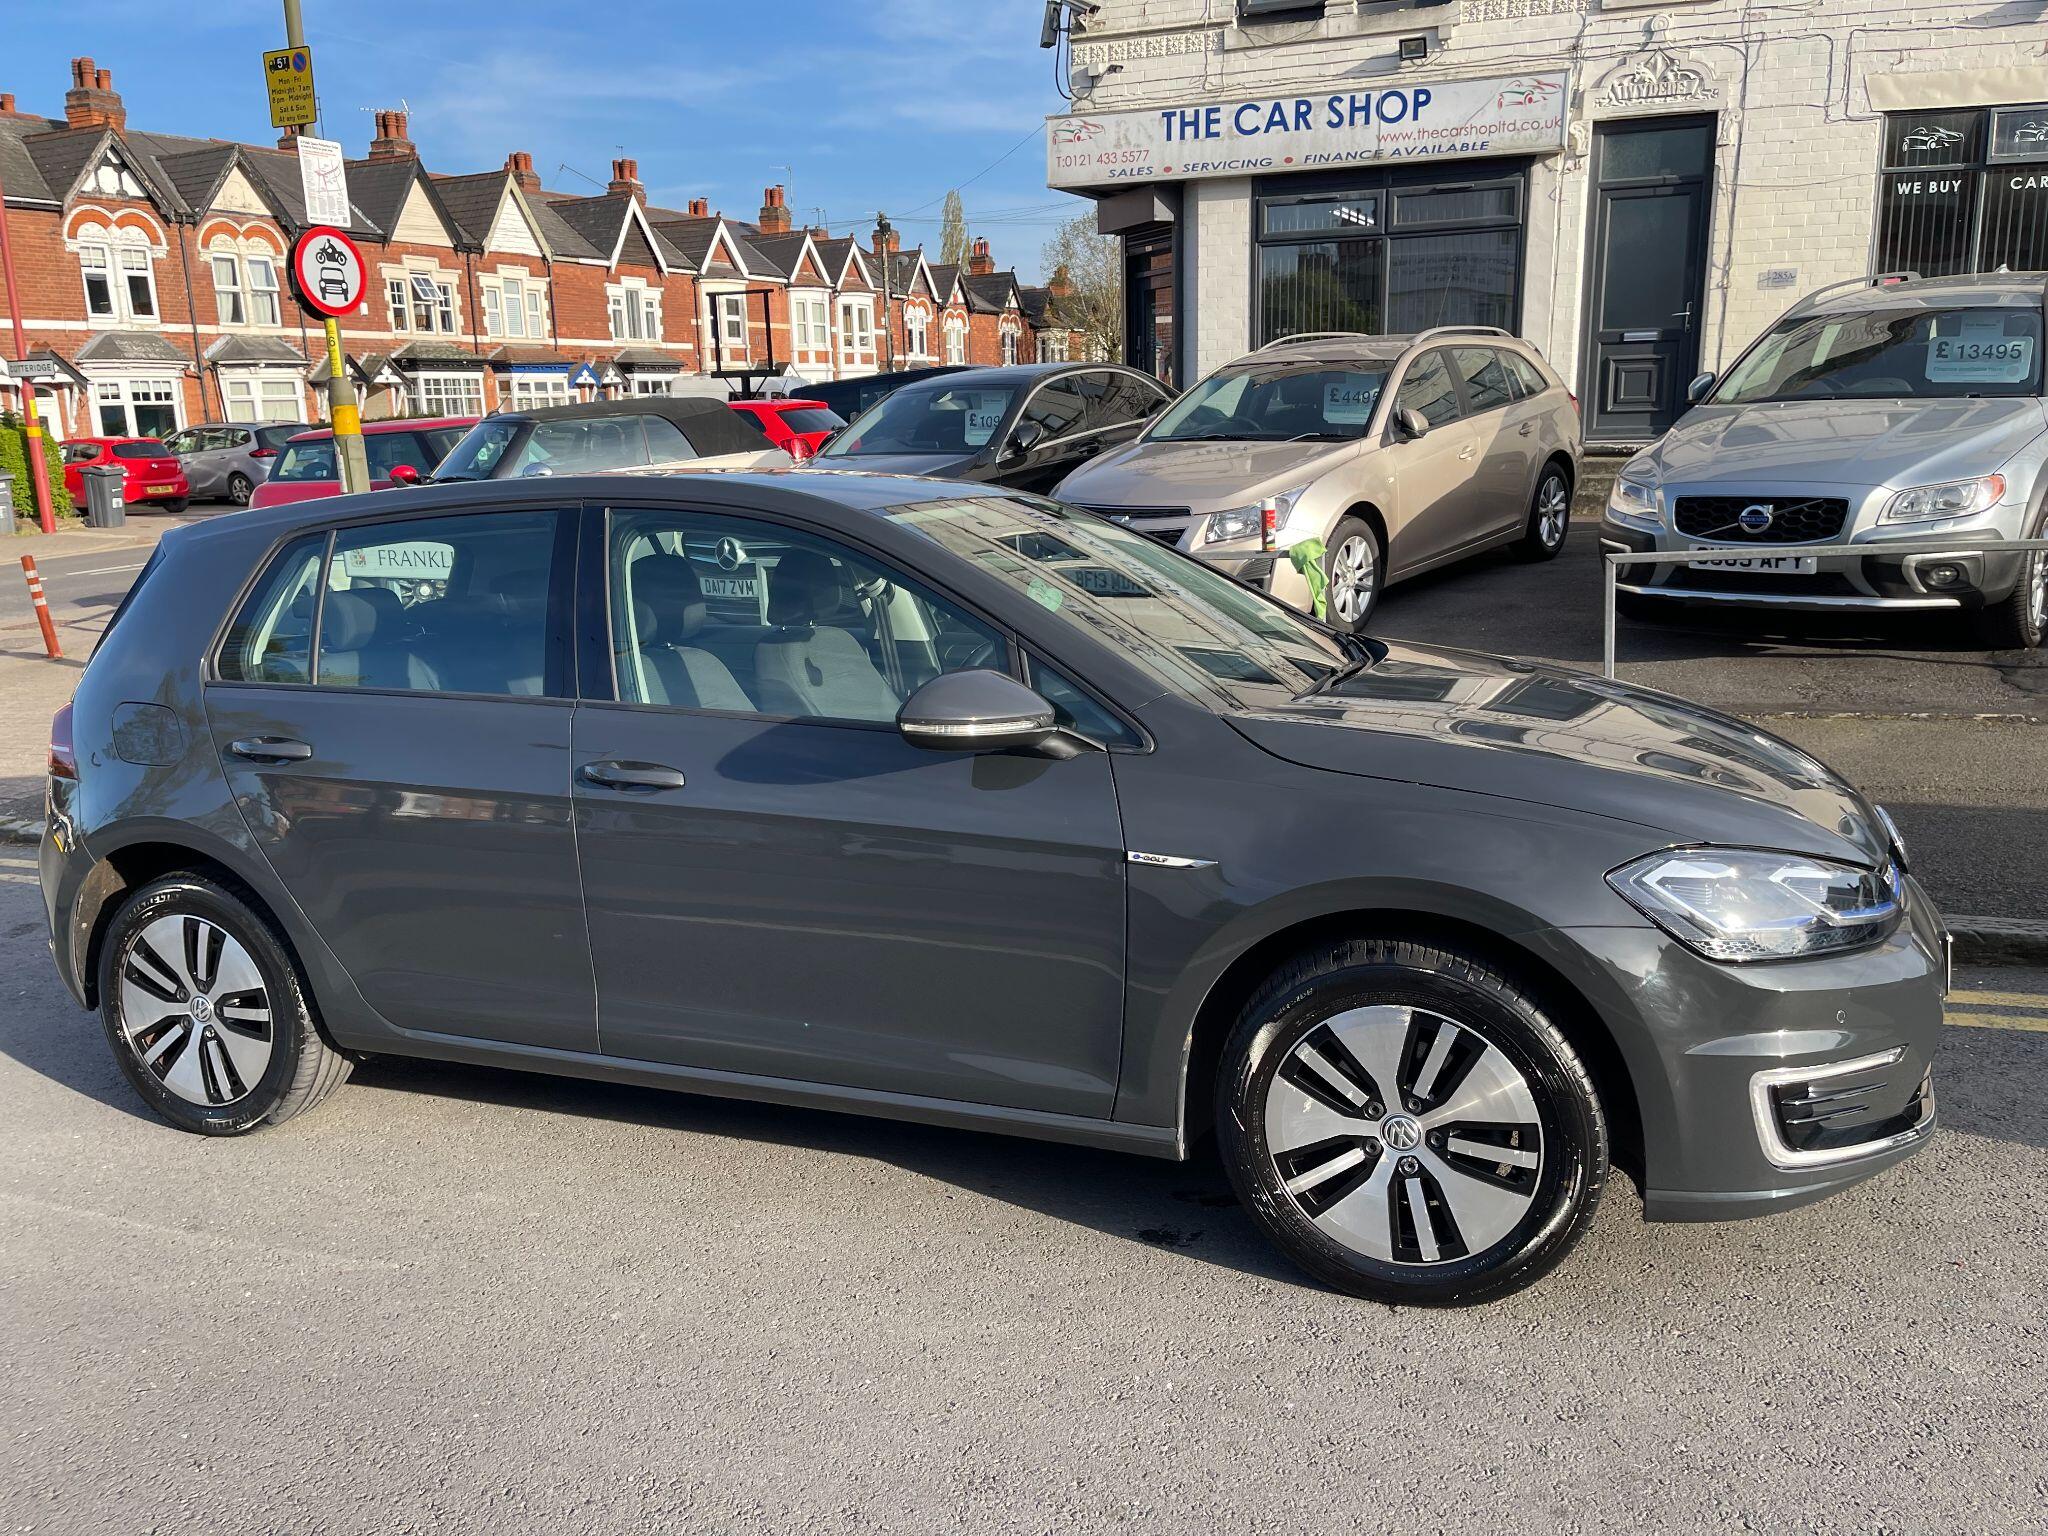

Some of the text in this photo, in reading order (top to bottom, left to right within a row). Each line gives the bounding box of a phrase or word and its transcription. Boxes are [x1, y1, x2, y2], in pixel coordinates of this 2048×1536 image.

[272, 87, 296, 95] Midnight
[289, 93, 312, 102] Midnight
[1161, 106, 1222, 142] THE
[1234, 99, 1313, 136] CAR
[1326, 88, 1432, 130] SHOP
[1376, 115, 1563, 143] www.thecarshopltd.co.uk
[1056, 150, 1150, 169] T:0121 433 5577
[1108, 141, 1490, 178] SALES SERVICING FINANCE AVAILABLE
[1897, 181, 1922, 195] WE
[1928, 179, 1962, 194] BUY
[1957, 344, 2022, 360] 13495
[704, 578, 754, 596] DA17 ZVM
